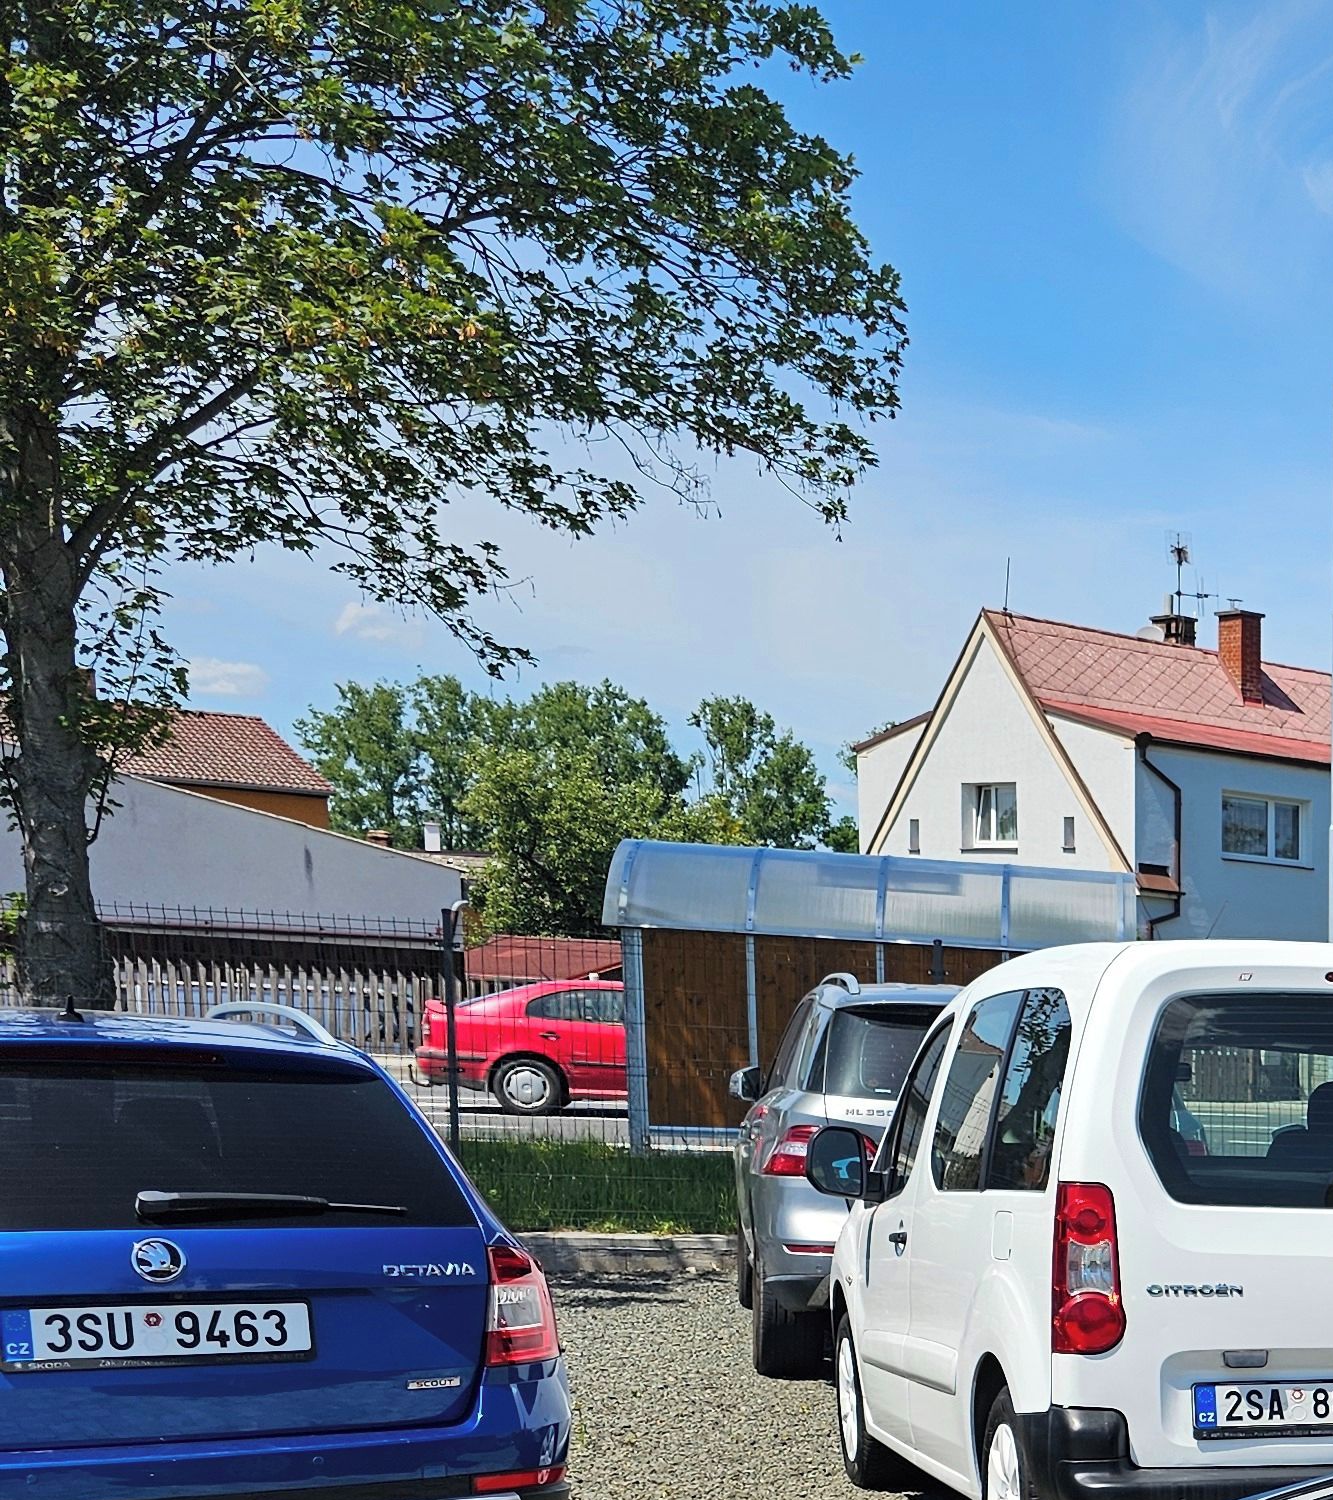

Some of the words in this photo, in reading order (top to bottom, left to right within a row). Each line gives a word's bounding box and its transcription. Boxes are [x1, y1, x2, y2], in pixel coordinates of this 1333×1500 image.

[382, 1262, 476, 1277] OCTAVIA
[1146, 1282, 1244, 1298] CITROËN
[7, 1342, 30, 1355] CZ
[44, 1311, 135, 1353] 3SU
[174, 1309, 288, 1349] 9463
[414, 1378, 456, 1388] SCOUT
[1198, 1412, 1215, 1423] CZ
[1224, 1388, 1285, 1422] 2SA
